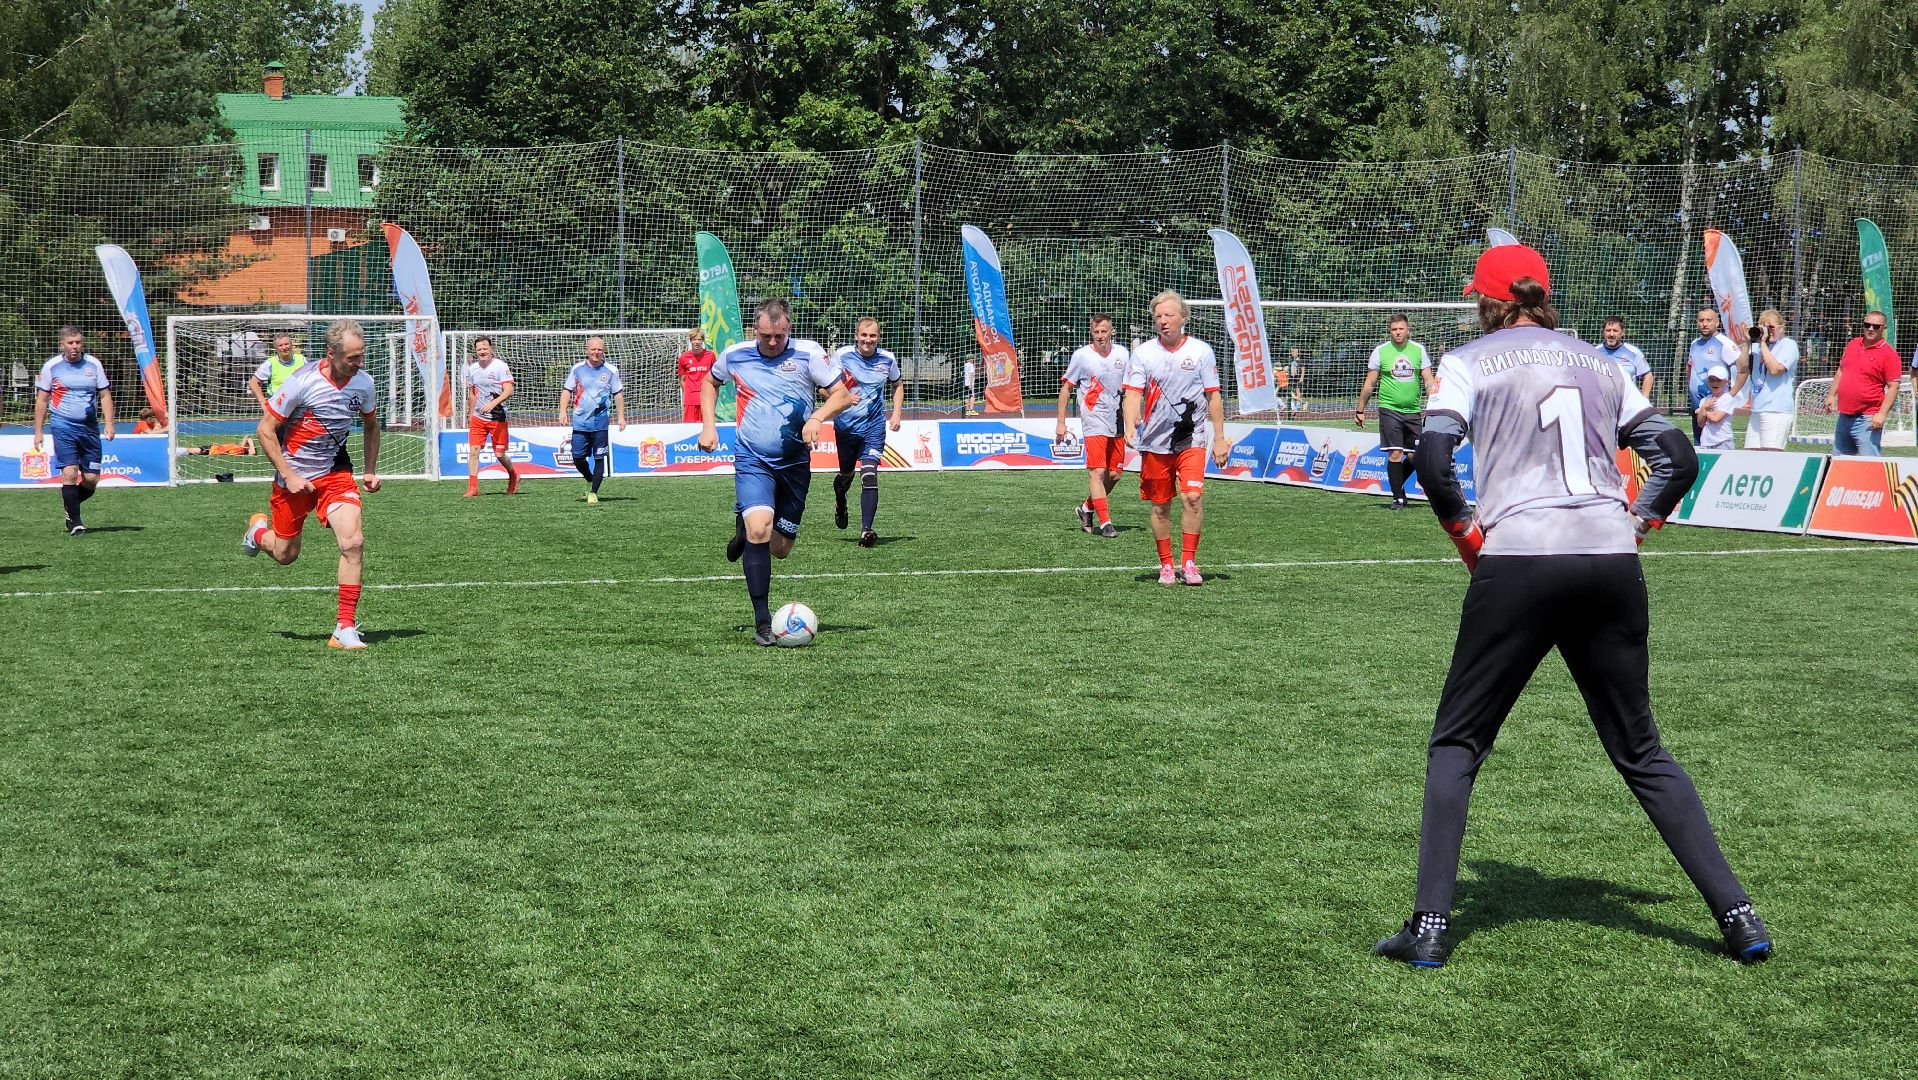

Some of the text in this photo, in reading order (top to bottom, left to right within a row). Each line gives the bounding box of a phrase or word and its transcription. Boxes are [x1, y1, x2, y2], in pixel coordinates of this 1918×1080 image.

[1480, 349, 1613, 377] НИГМАТУЛЛИН
[956, 432, 1027, 444] МОСОБЛ
[1536, 385, 1599, 496] 1
[957, 443, 1030, 455] СПОРТ
[674, 454, 736, 464] ГУБЕРНАТО
[1359, 455, 1386, 467] КОМАНДА
[1826, 486, 1885, 509] 80 ПОБЕДА!
